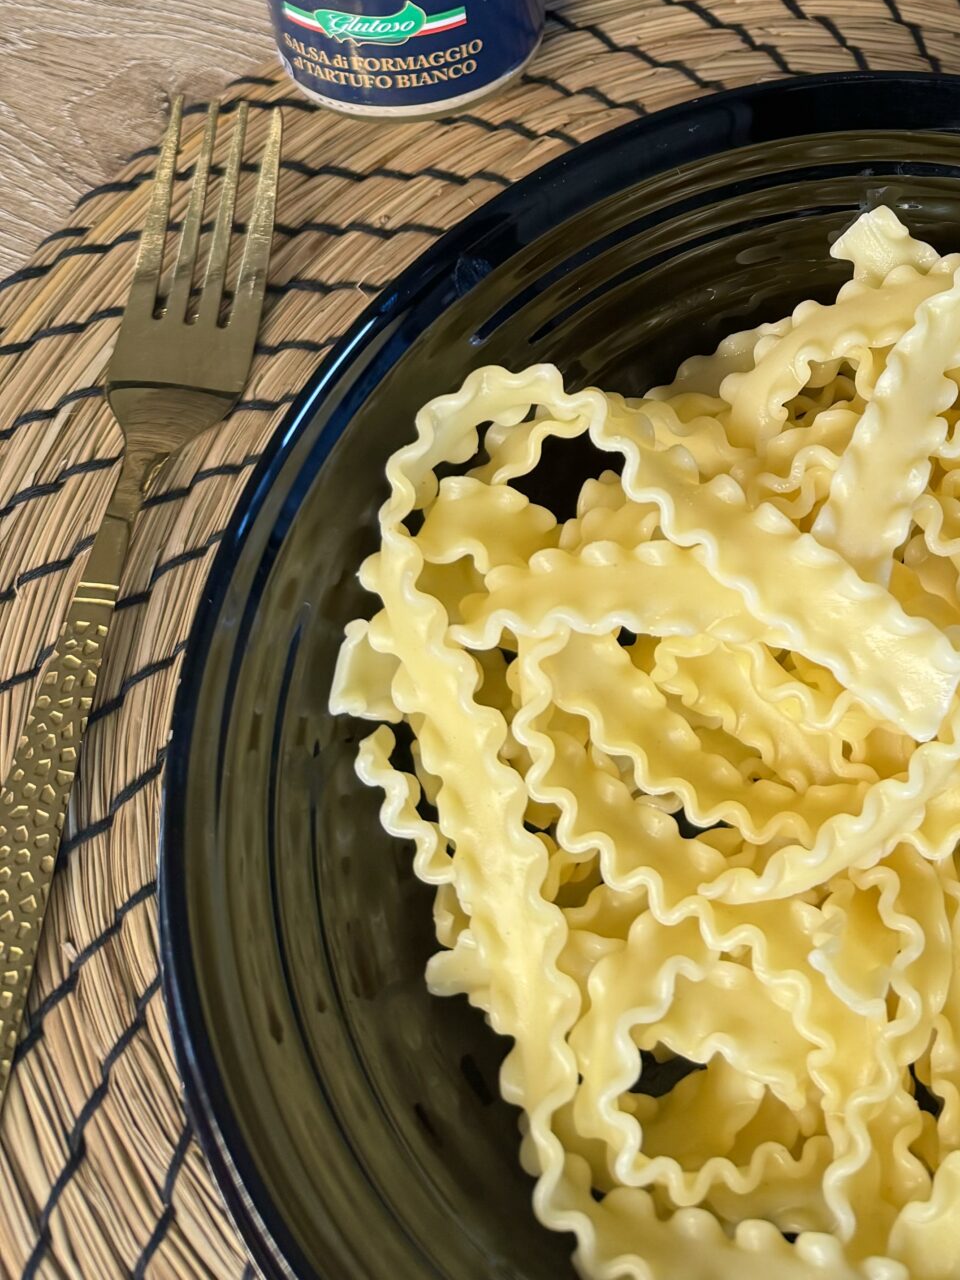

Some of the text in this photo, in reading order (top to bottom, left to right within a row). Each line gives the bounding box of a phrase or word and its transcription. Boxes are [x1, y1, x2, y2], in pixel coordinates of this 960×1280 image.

[328, 13, 415, 34] Glutoso
[283, 32, 483, 72] SALSA di FORMAGGIO
[303, 59, 393, 89] TARTUFO
[395, 60, 478, 89] BIANCO
